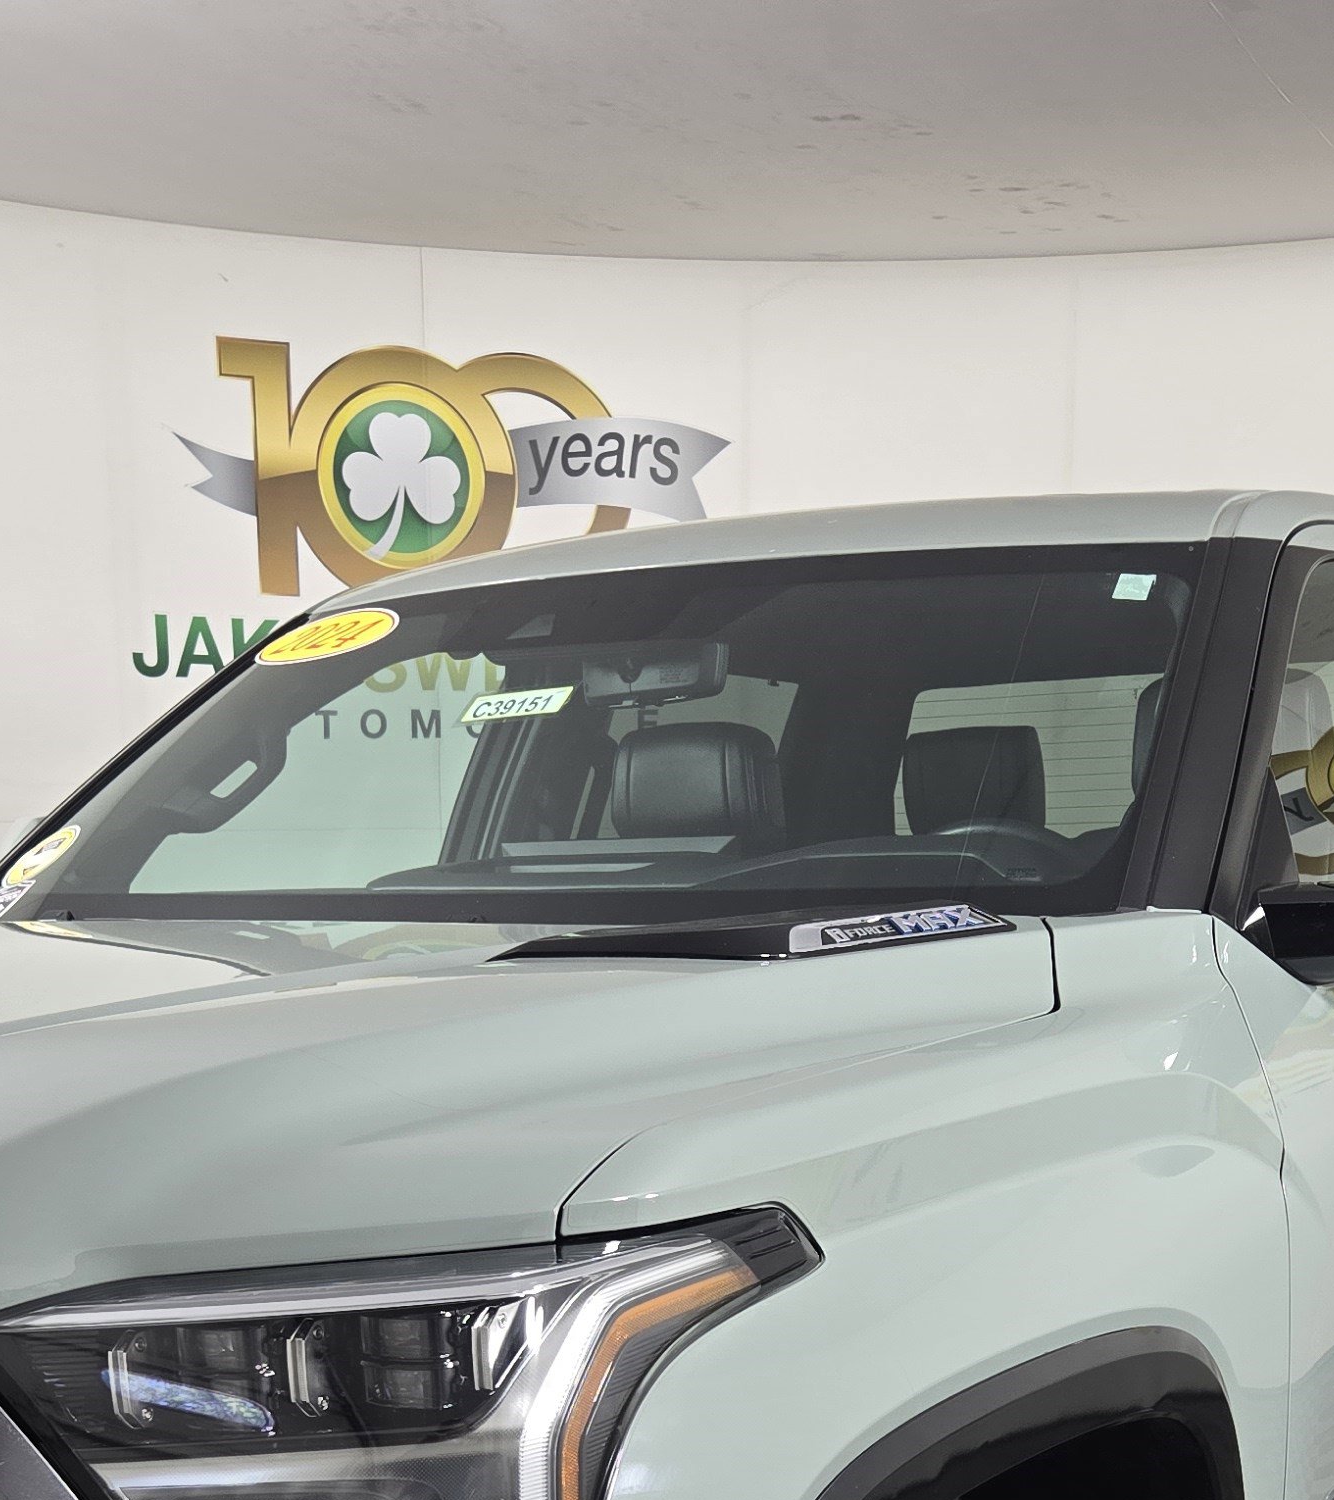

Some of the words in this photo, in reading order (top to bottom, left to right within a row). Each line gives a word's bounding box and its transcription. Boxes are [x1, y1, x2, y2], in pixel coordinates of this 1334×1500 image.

[527, 429, 680, 496] years
[132, 613, 281, 678] JAK
[267, 618, 386, 657] 2024
[472, 694, 554, 719] C39151
[887, 906, 985, 936] MAX
